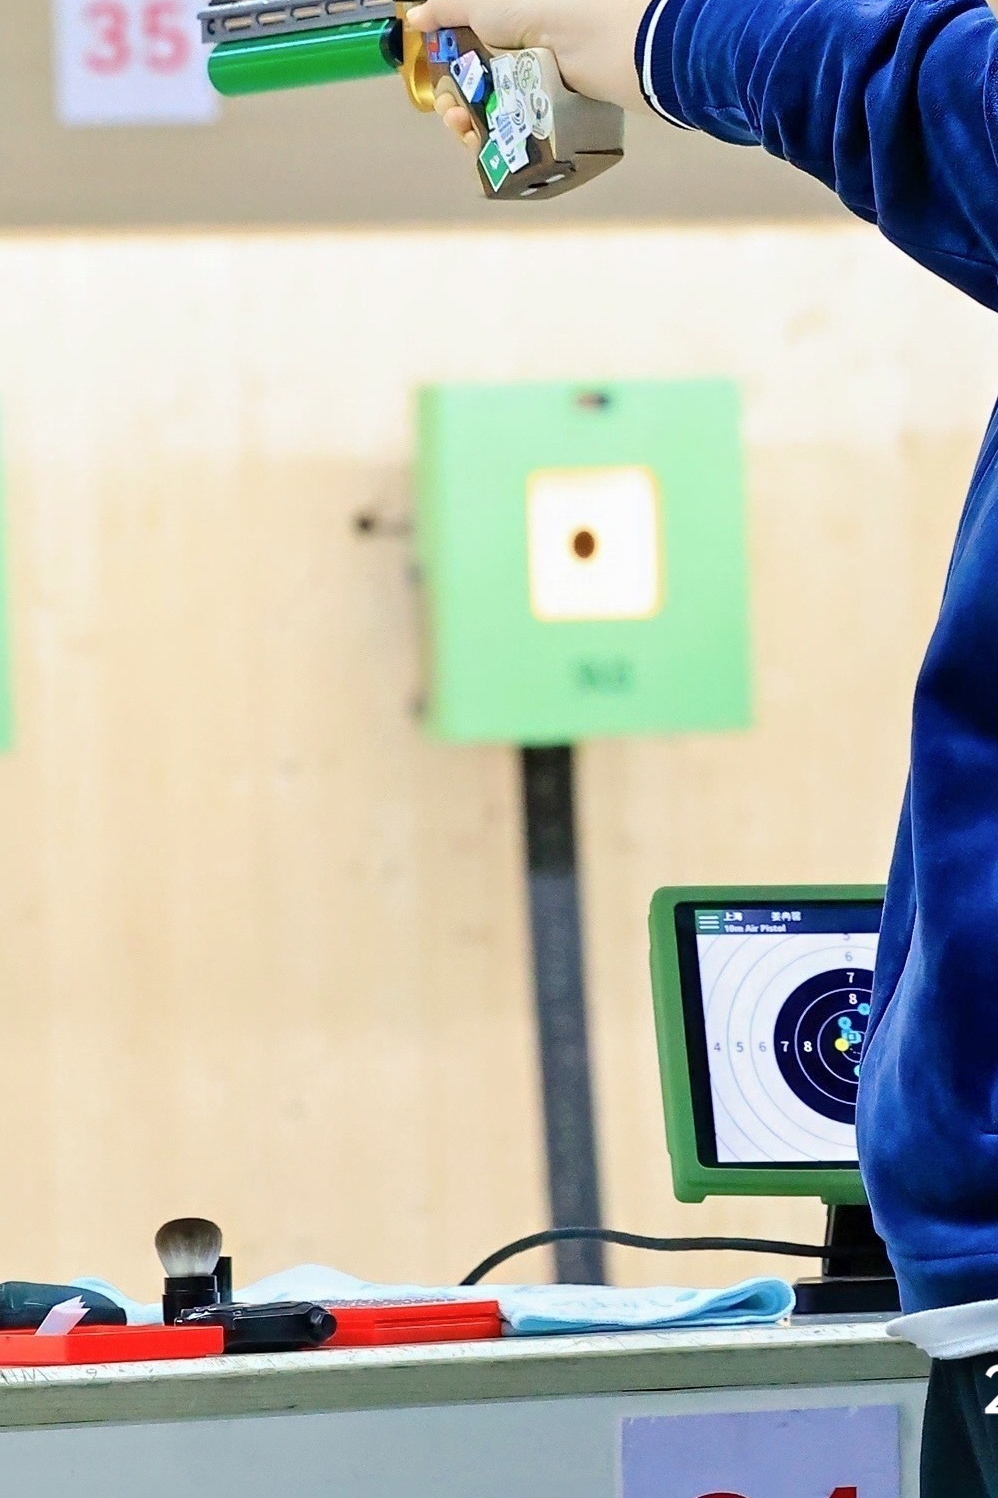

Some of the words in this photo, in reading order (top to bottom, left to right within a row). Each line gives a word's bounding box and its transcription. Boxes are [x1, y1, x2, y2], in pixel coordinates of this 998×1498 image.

[745, 924, 759, 933] Air
[760, 923, 787, 933] Pistol
[845, 951, 854, 962] 6
[846, 972, 855, 984] 7
[848, 993, 858, 1005] 8
[736, 1042, 745, 1053] 5
[759, 1042, 768, 1052] 6
[780, 1041, 790, 1053] 7
[803, 1040, 813, 1053] 8
